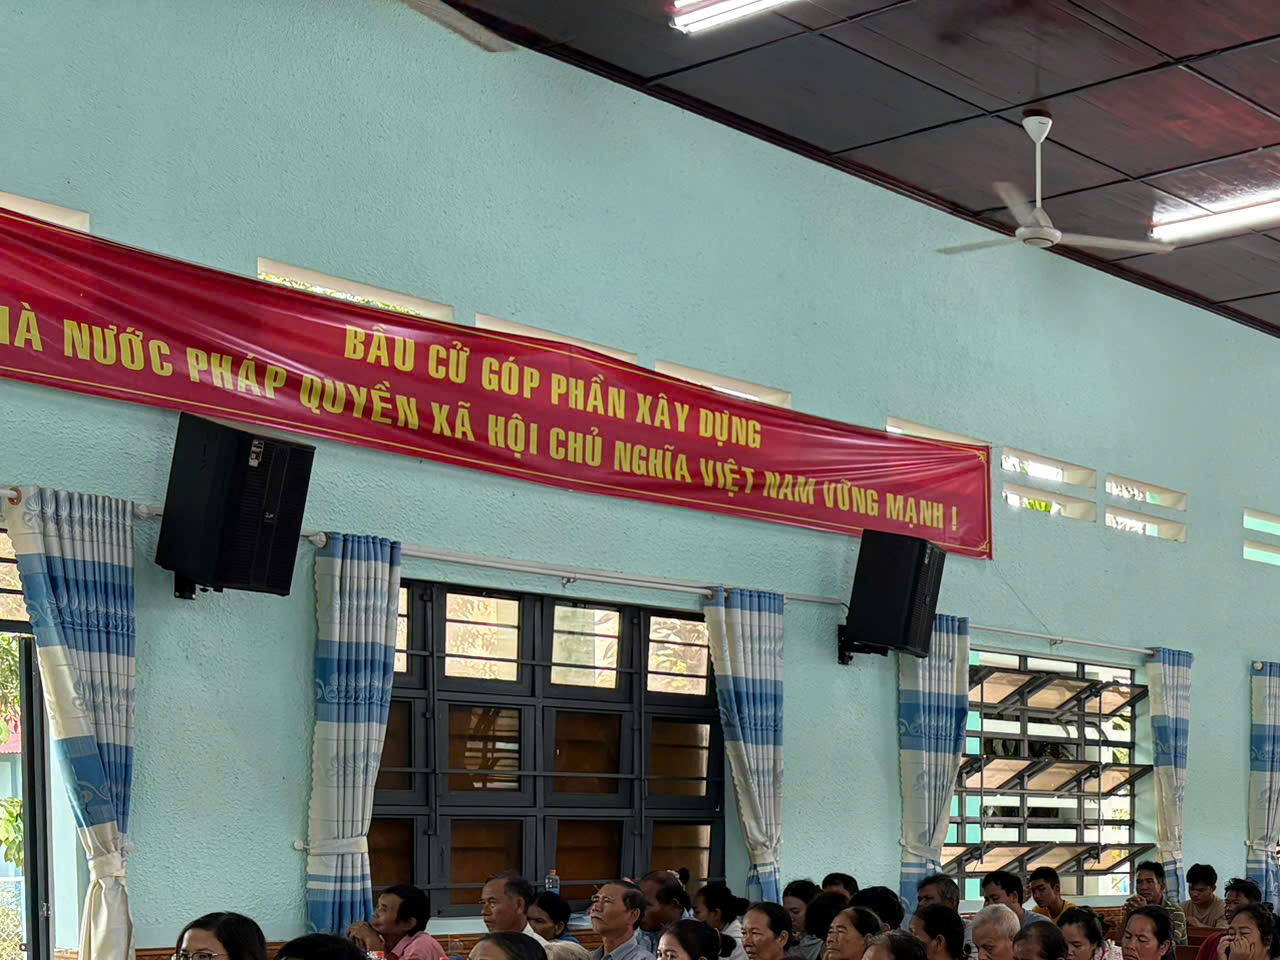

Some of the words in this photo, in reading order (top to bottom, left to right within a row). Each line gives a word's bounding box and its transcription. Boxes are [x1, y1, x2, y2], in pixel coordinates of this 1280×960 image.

[63, 318, 173, 377] NƯỚC
[186, 347, 287, 400] PHÁP
[300, 374, 420, 431] QUYỀN
[431, 401, 475, 442] XÃ
[488, 413, 538, 459] HỘI
[550, 427, 603, 467] CHỦ
[614, 445, 692, 483] NGHĨA
[700, 458, 755, 497] VIỆT
[763, 471, 817, 505] NAM
[823, 479, 879, 517] VỮNG
[886, 493, 944, 529] MẠNH
[951, 505, 958, 531] !
[428, 340, 470, 384] CỬ
[481, 356, 540, 399] GÓP
[551, 374, 626, 419] PHẦN
[636, 392, 689, 432] XÂY
[699, 410, 761, 449] DỰNG
